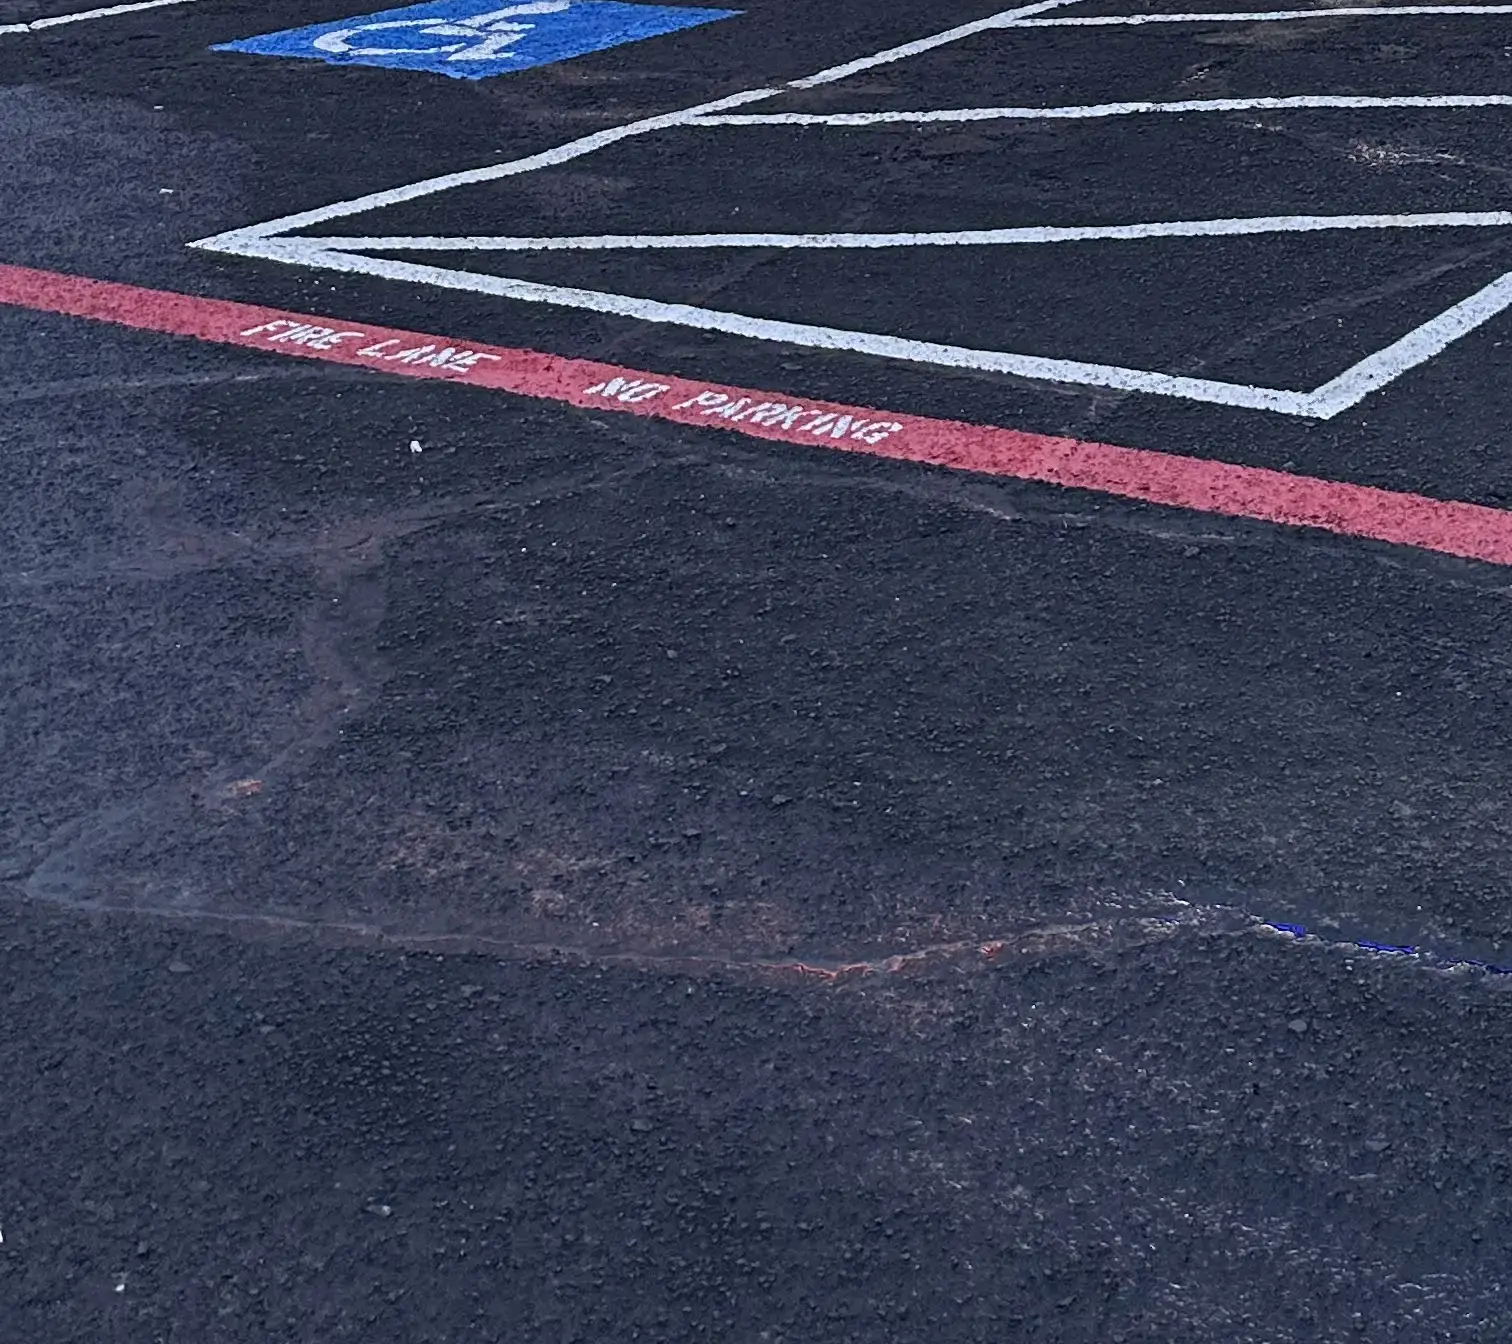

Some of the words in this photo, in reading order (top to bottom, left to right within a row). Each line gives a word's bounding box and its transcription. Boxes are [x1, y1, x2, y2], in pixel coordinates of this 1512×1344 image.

[240, 320, 365, 350] FIRE
[356, 339, 502, 372] LANE
[583, 377, 671, 403] NO
[672, 390, 903, 445] PARKING
